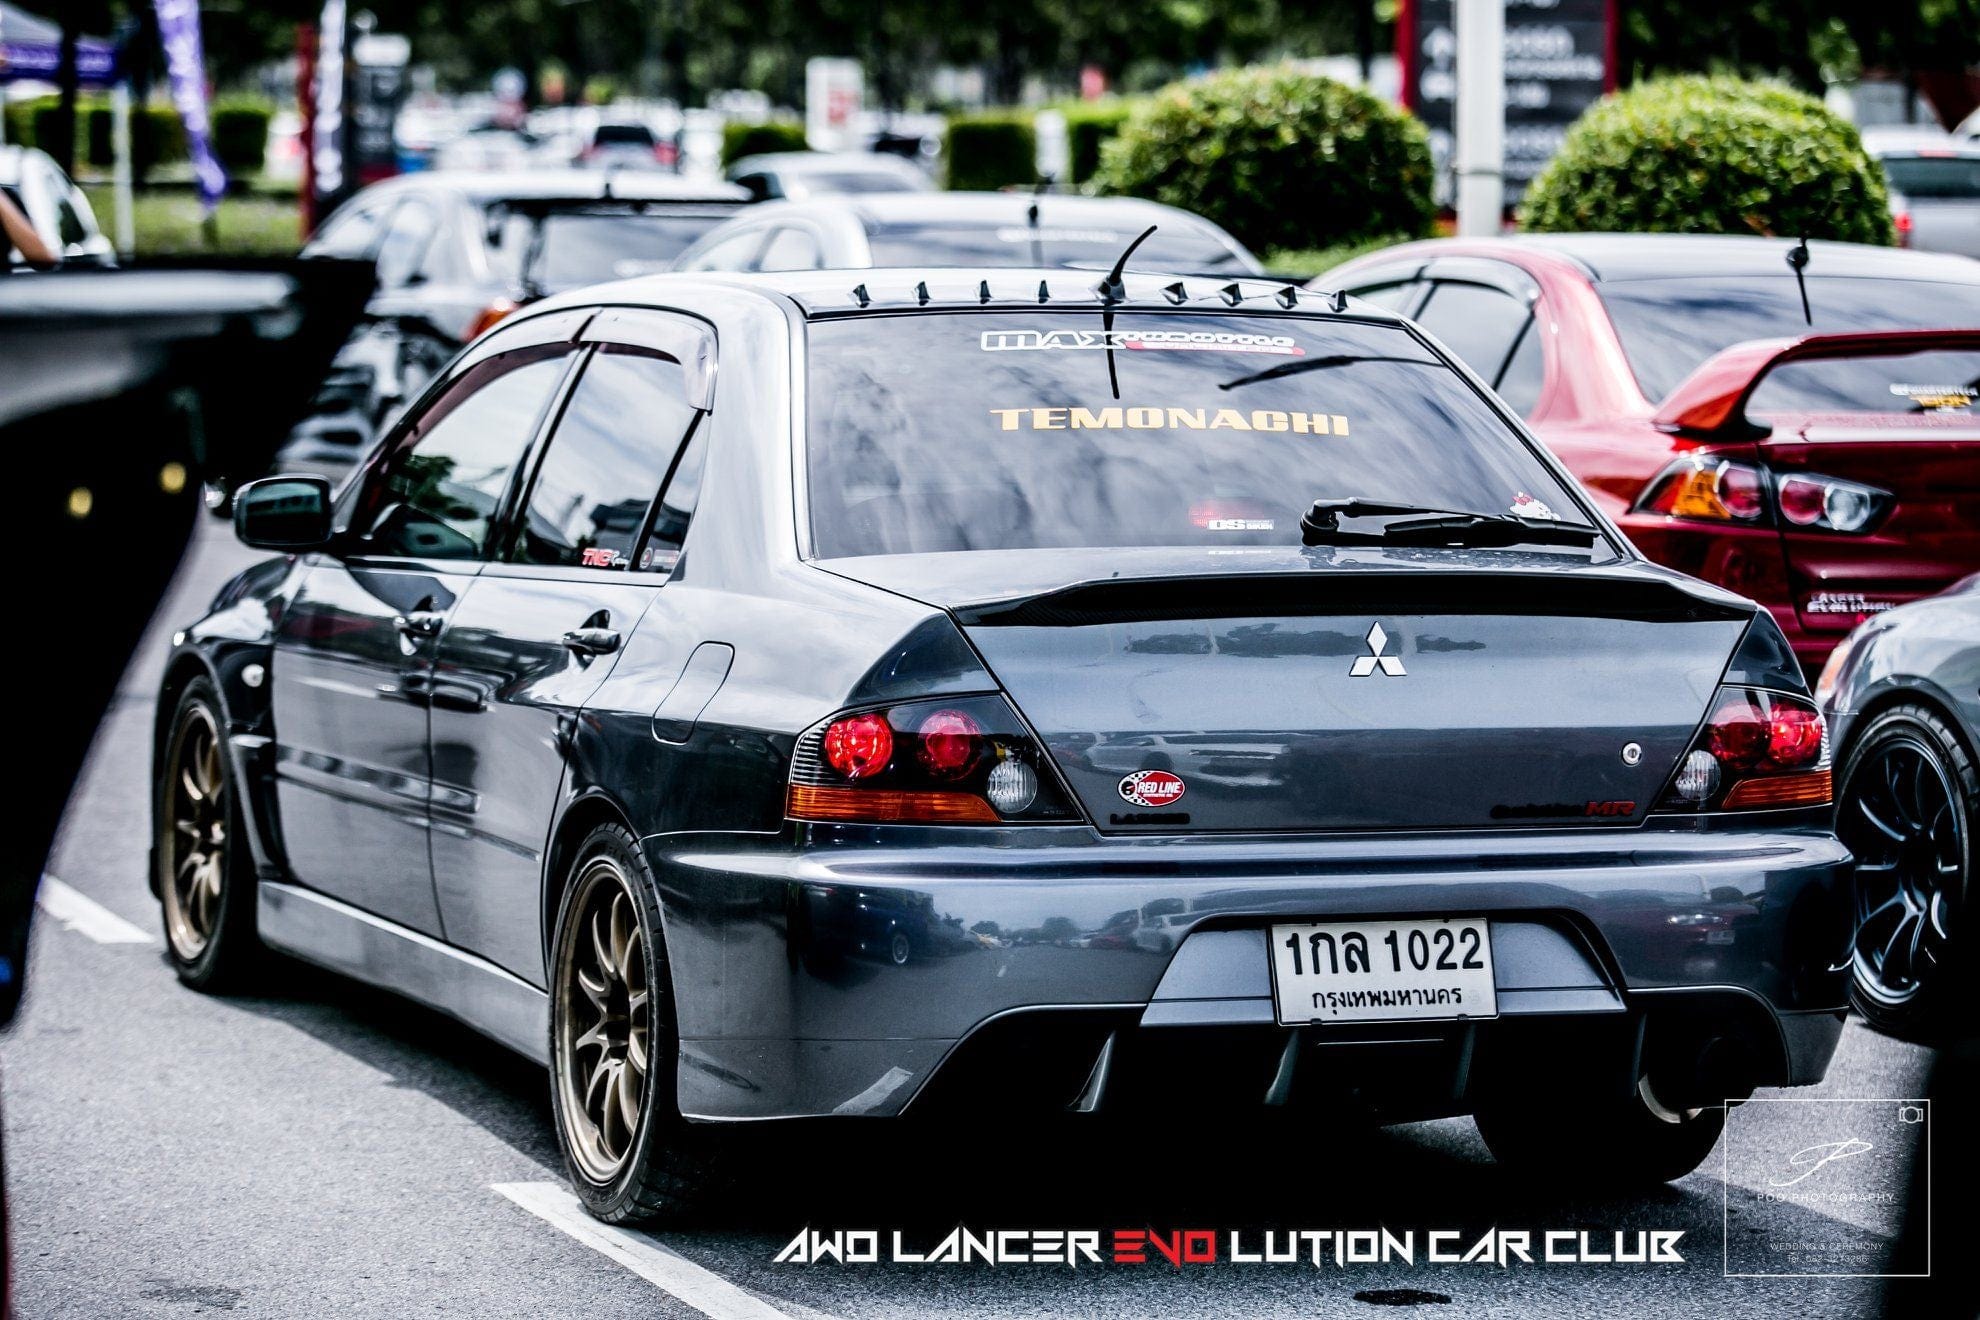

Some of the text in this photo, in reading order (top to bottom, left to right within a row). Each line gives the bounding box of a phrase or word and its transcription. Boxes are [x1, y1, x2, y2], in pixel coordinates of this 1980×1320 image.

[989, 407, 1350, 436] TEMONACHI
[1136, 781, 1182, 794] RED LINE
[1584, 801, 1636, 816] MR
[1285, 927, 1484, 976] 1กล 1022
[1311, 986, 1462, 1015] กรุงเทพมหานคร
